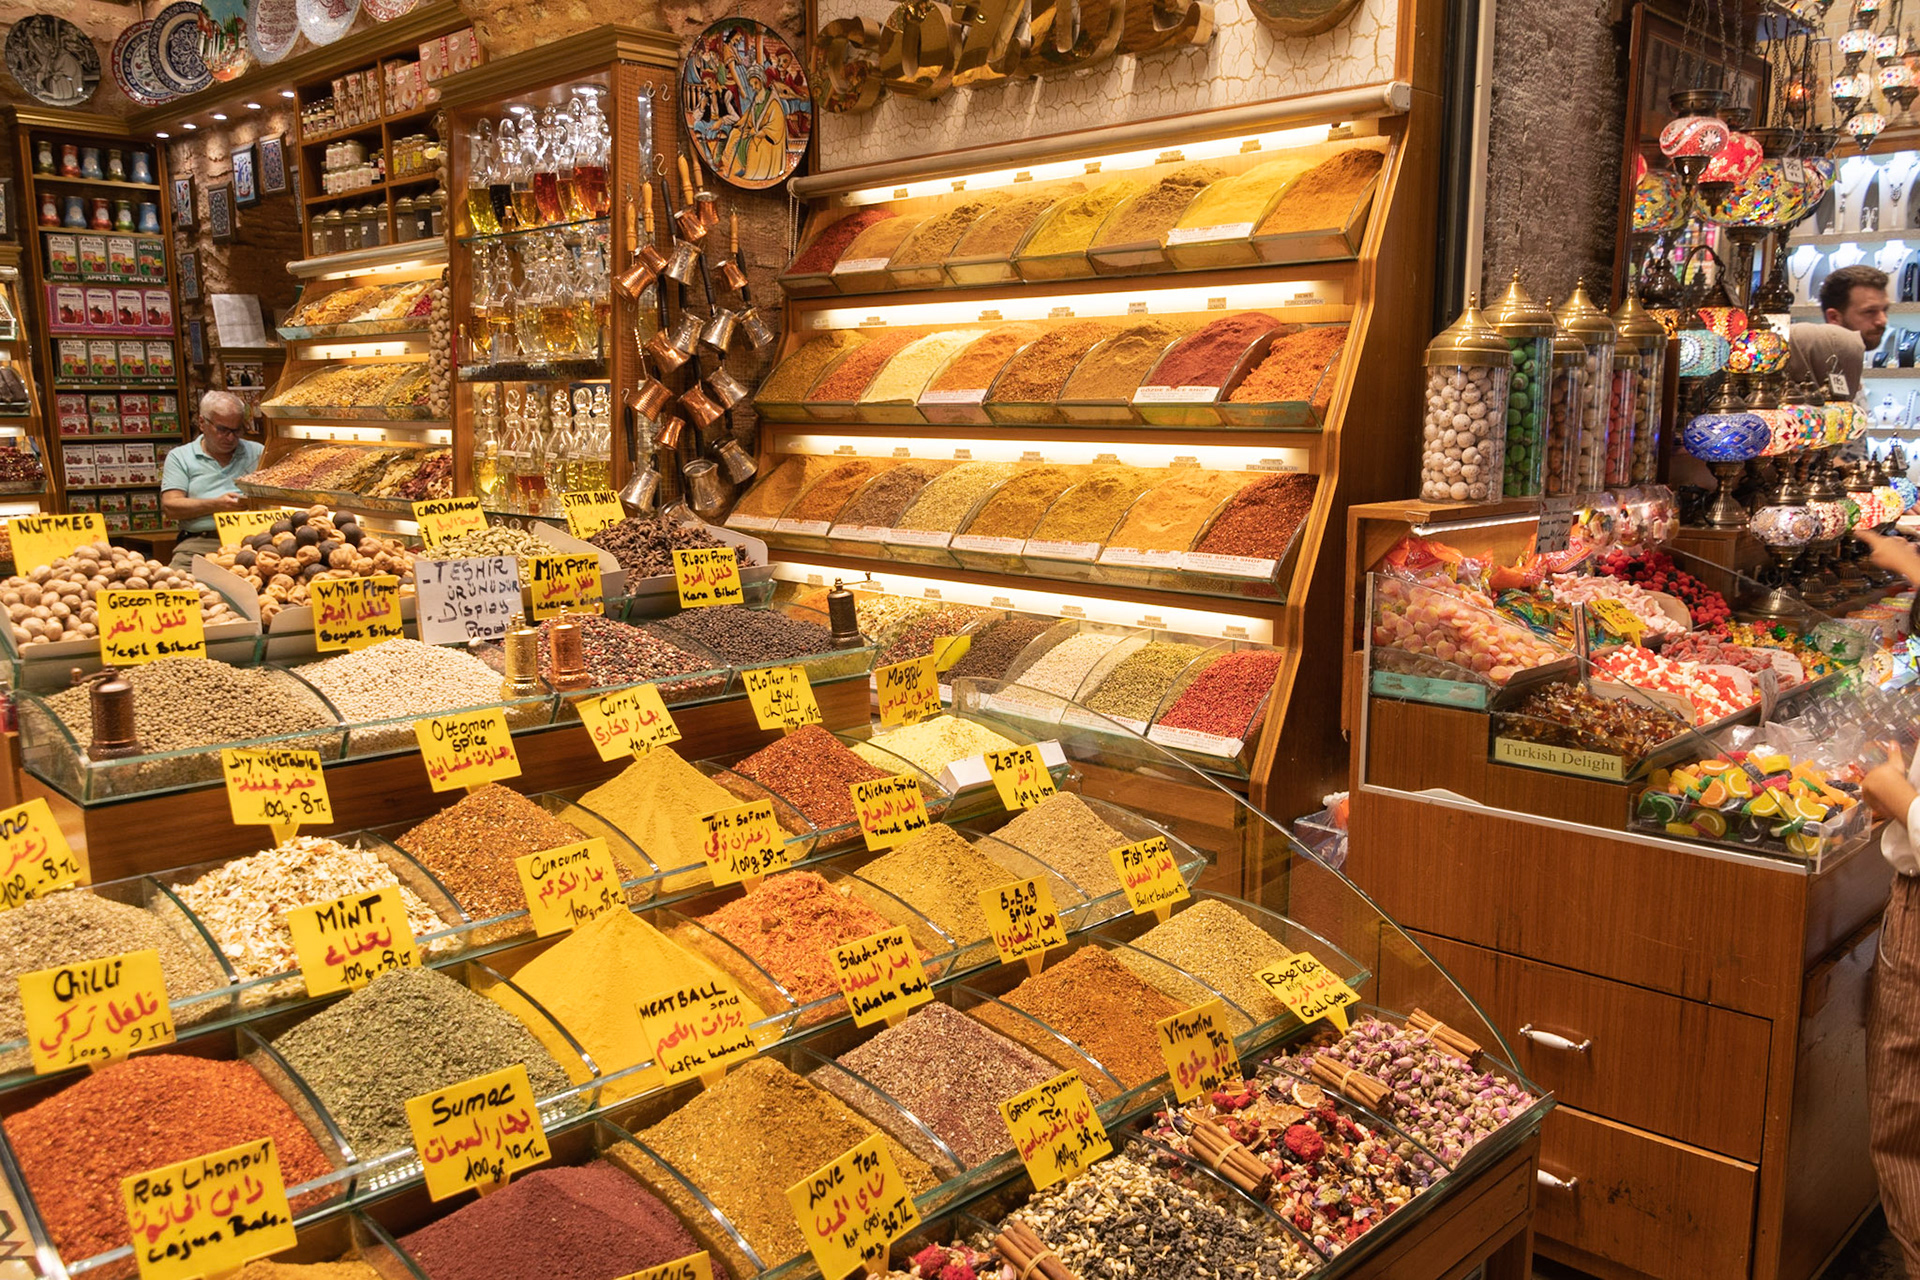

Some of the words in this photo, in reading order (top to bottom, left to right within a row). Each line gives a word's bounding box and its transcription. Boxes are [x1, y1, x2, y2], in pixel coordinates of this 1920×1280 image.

[564, 494, 592, 508] STAR
[594, 491, 616, 506] ANIS
[18, 515, 94, 534] NUTMEG
[218, 514, 240, 528] DRY
[249, 512, 293, 526] LEMON
[680, 552, 710, 567] Black
[683, 590, 708, 602] Kara
[714, 586, 740, 599] Biber
[366, 624, 404, 638] Biber
[156, 640, 205, 654] Biber
[886, 660, 923, 690] Maggi
[432, 717, 496, 742] Ottoman
[1503, 742, 1557, 762] Turkish
[1562, 750, 1616, 772] Delight
[1122, 846, 1144, 870] Fish
[1262, 968, 1298, 990] Rose
[1290, 959, 1320, 976] Tea
[432, 1083, 516, 1128] Sumac
[133, 1178, 173, 1207] Ras
